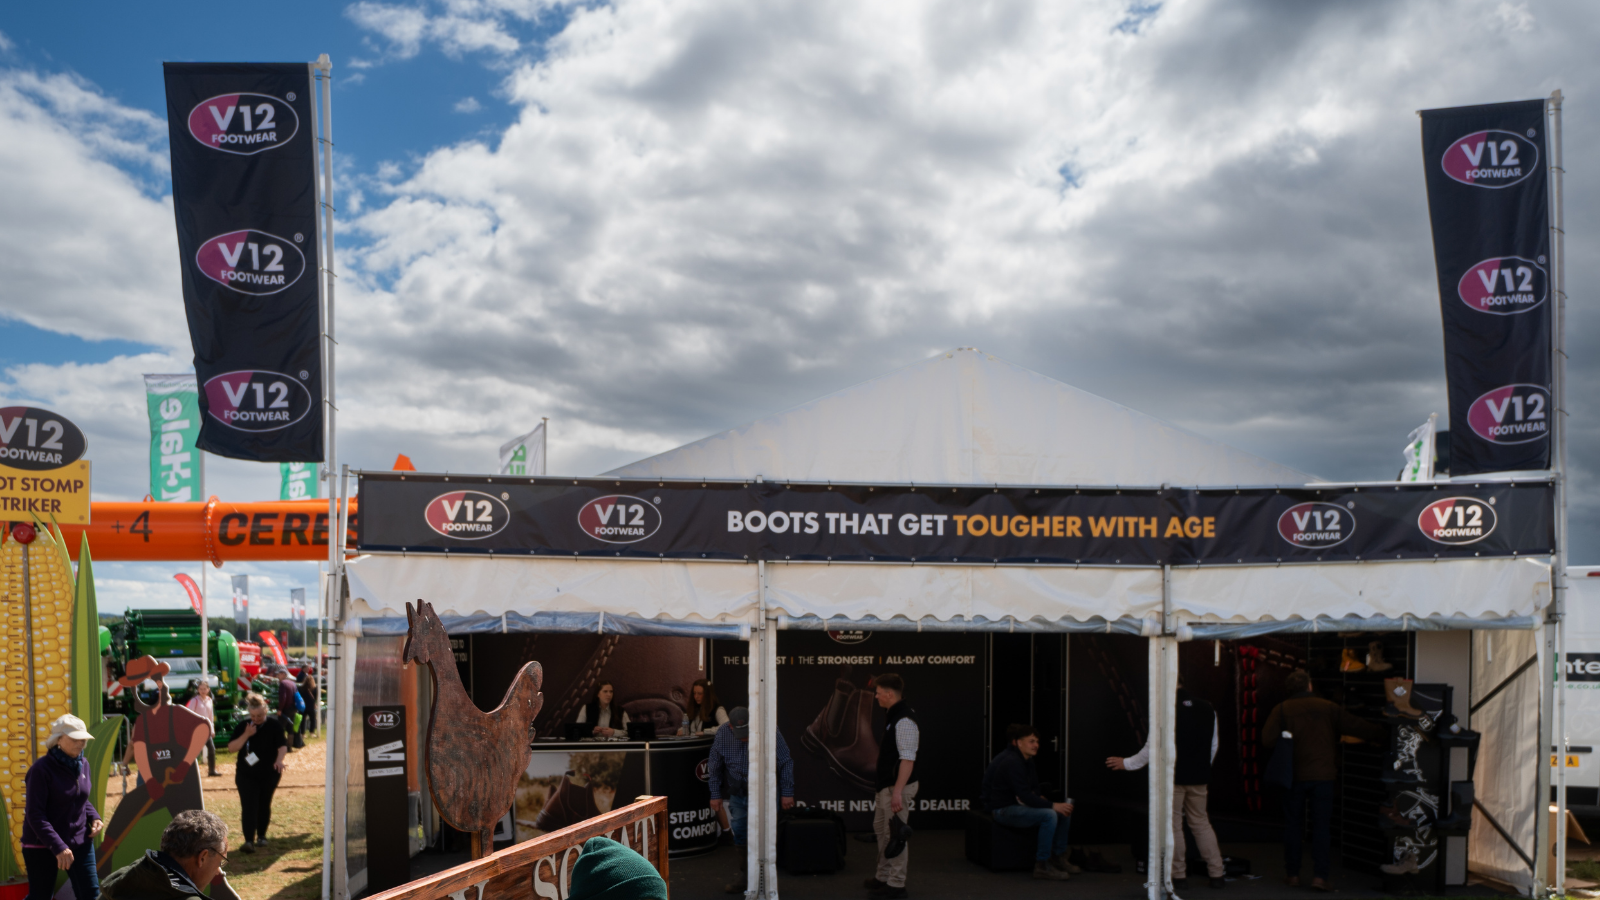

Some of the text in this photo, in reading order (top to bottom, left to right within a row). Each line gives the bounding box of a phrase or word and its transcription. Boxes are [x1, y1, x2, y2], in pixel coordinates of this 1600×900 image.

[208, 103, 276, 132] V12
[211, 131, 277, 144] FOOTWEAR
[1460, 139, 1520, 167] V12
[1465, 167, 1522, 179] FOOTWEAR
[217, 242, 284, 272] V12
[220, 270, 285, 285] FOOTWEAR
[1477, 266, 1533, 294] V12
[1480, 294, 1535, 307] FOOTWEAR
[221, 380, 289, 409] V12
[224, 410, 290, 421] FOOTWEAR
[1485, 393, 1546, 423] V12
[0, 414, 64, 450] V12
[1488, 421, 1547, 436] FOOTWEAR
[0, 447, 63, 464] OOTWEAR
[21, 477, 84, 493] STOMP
[0, 497, 62, 513] TRIKER
[441, 500, 493, 522] V12
[594, 504, 645, 526] V12
[1292, 509, 1341, 531] V12
[1432, 505, 1482, 528] V12
[442, 522, 493, 532] FOOTWEAR
[594, 526, 645, 536] FOOTWEAR
[727, 510, 1216, 539] BOOTS THAT GET TOUGHER WITH AGE
[1433, 527, 1482, 537] FOOTWEAR
[1292, 531, 1341, 541] FOOTWEAR
[723, 656, 740, 665] THE
[798, 656, 874, 665] THE STRONGEST
[885, 656, 976, 665] ALL-DAY COMFORT
[374, 714, 394, 723] V12
[156, 749, 171, 757] V12
[819, 800, 845, 812] THE
[919, 799, 971, 811] DEALER
[669, 810, 697, 824] STEP
[698, 808, 710, 821] UP
[673, 821, 717, 839] COMFOR
